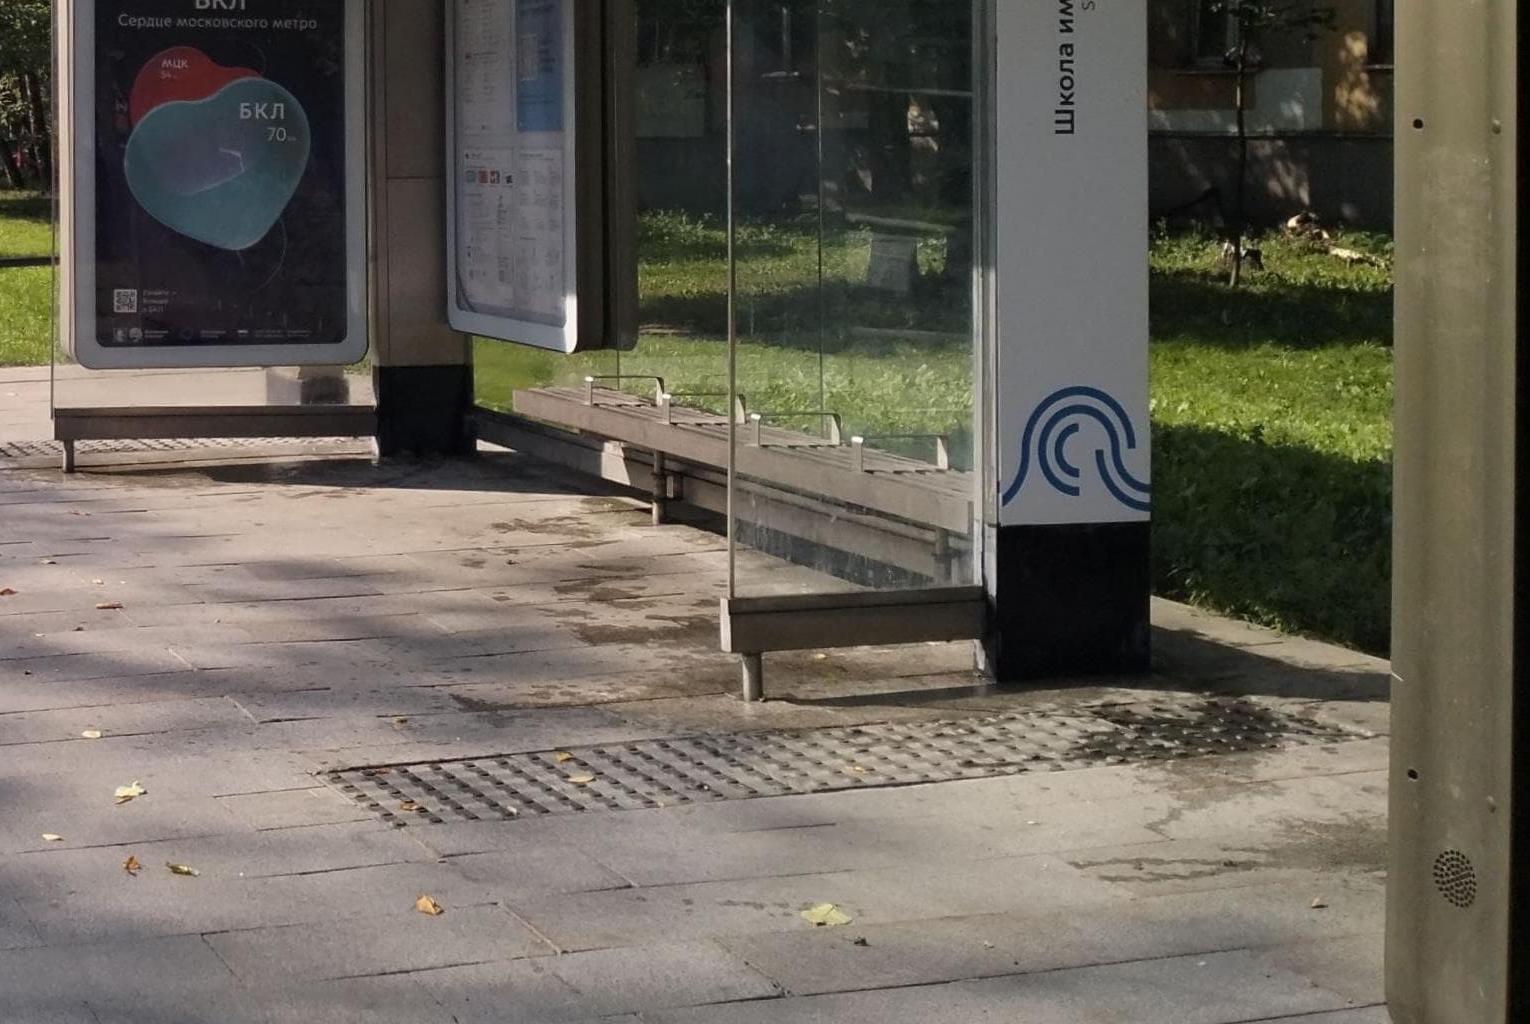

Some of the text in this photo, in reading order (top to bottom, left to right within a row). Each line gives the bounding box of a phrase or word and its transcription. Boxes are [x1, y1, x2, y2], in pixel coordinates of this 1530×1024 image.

[118, 13, 317, 32] Сердце московского метро
[1054, 43, 1074, 134] Школа
[240, 102, 285, 119] БКЛ
[266, 127, 286, 142] 70
